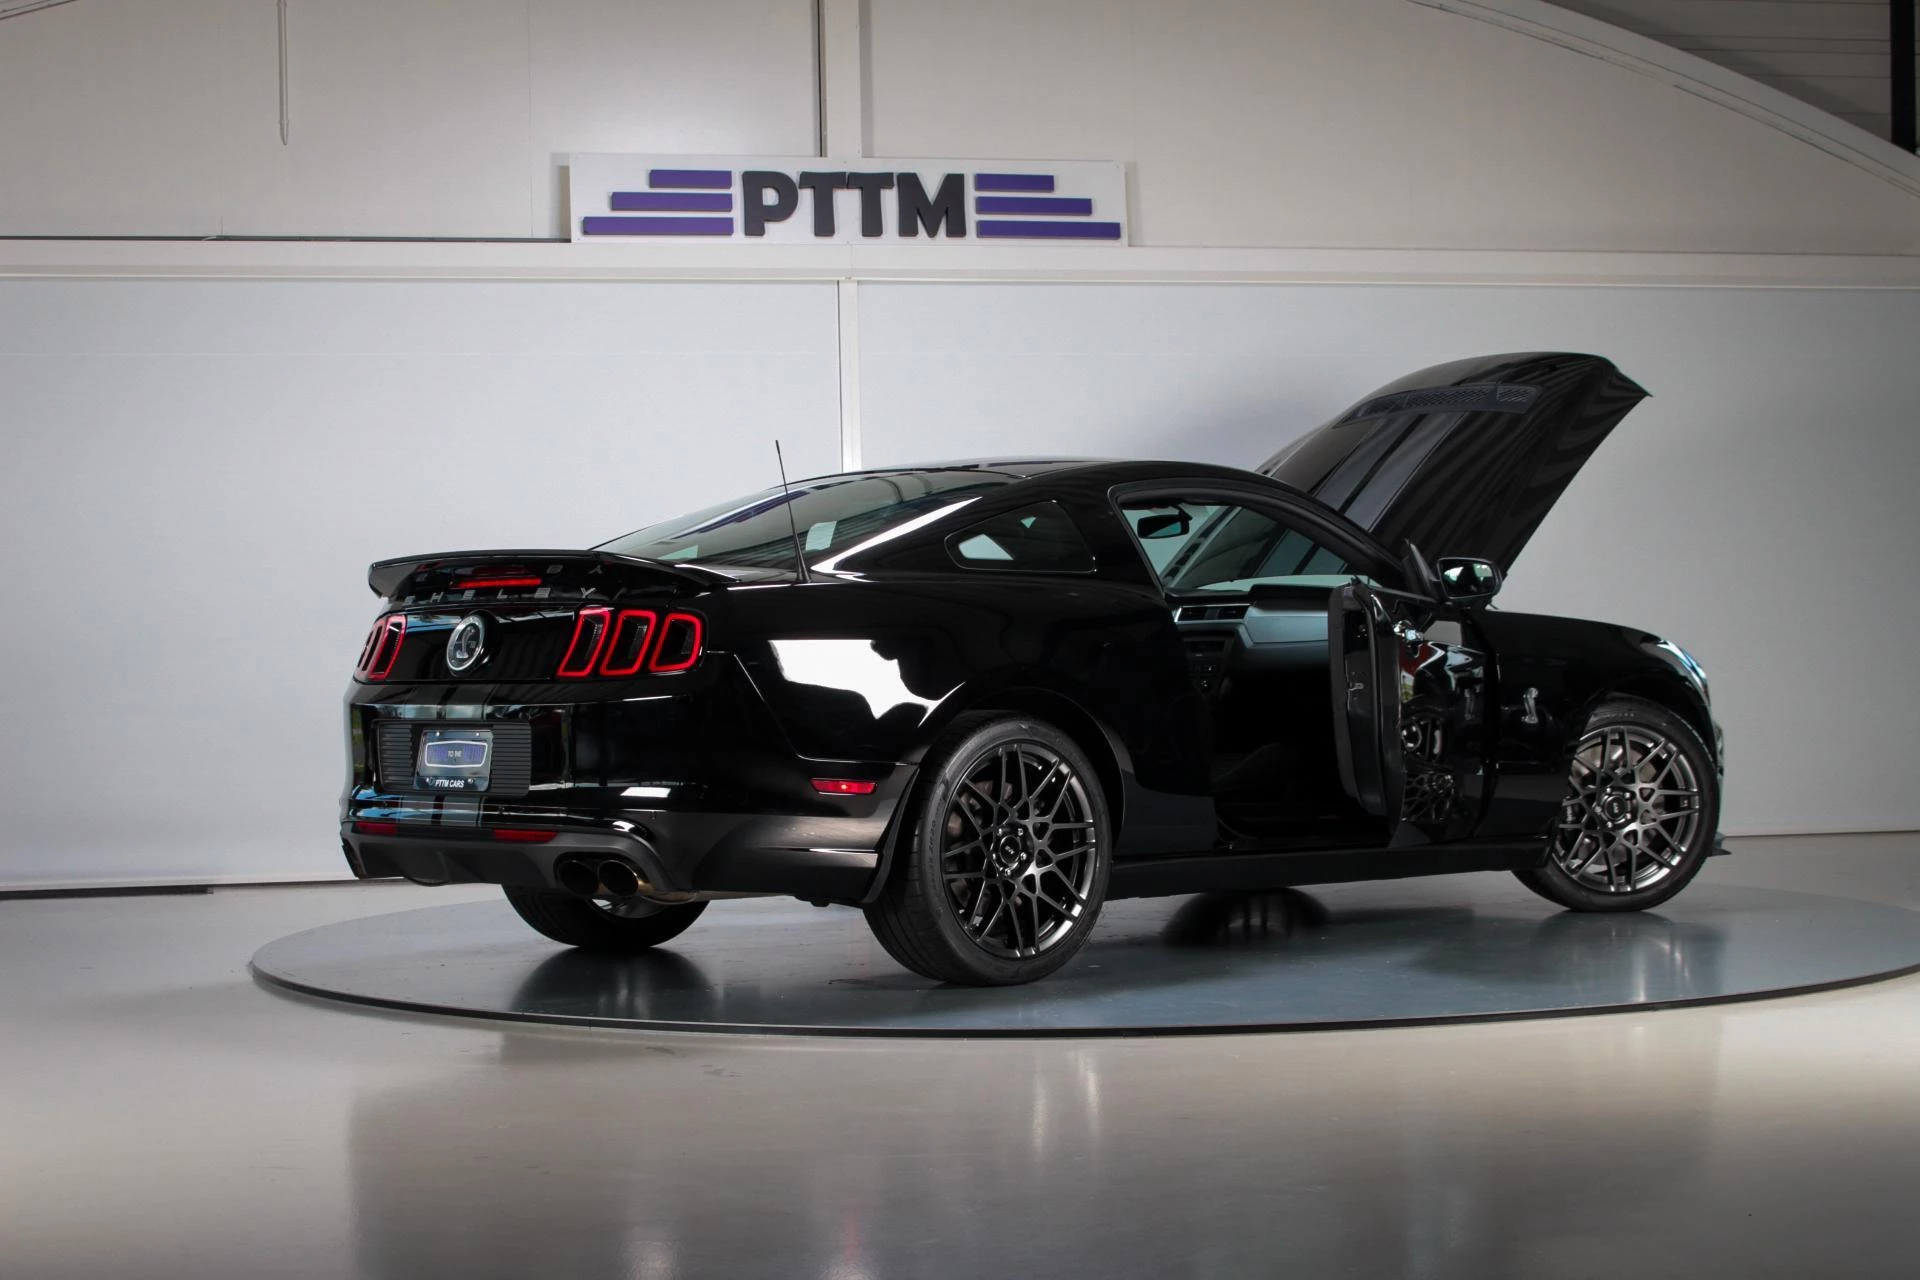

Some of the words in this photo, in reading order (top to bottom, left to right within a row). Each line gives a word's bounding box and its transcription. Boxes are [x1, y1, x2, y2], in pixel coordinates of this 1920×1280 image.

[742, 170, 966, 238] PTTM
[404, 587, 597, 604] SHELBY
[434, 779, 449, 788] PTTM
[449, 779, 465, 788] CARS
